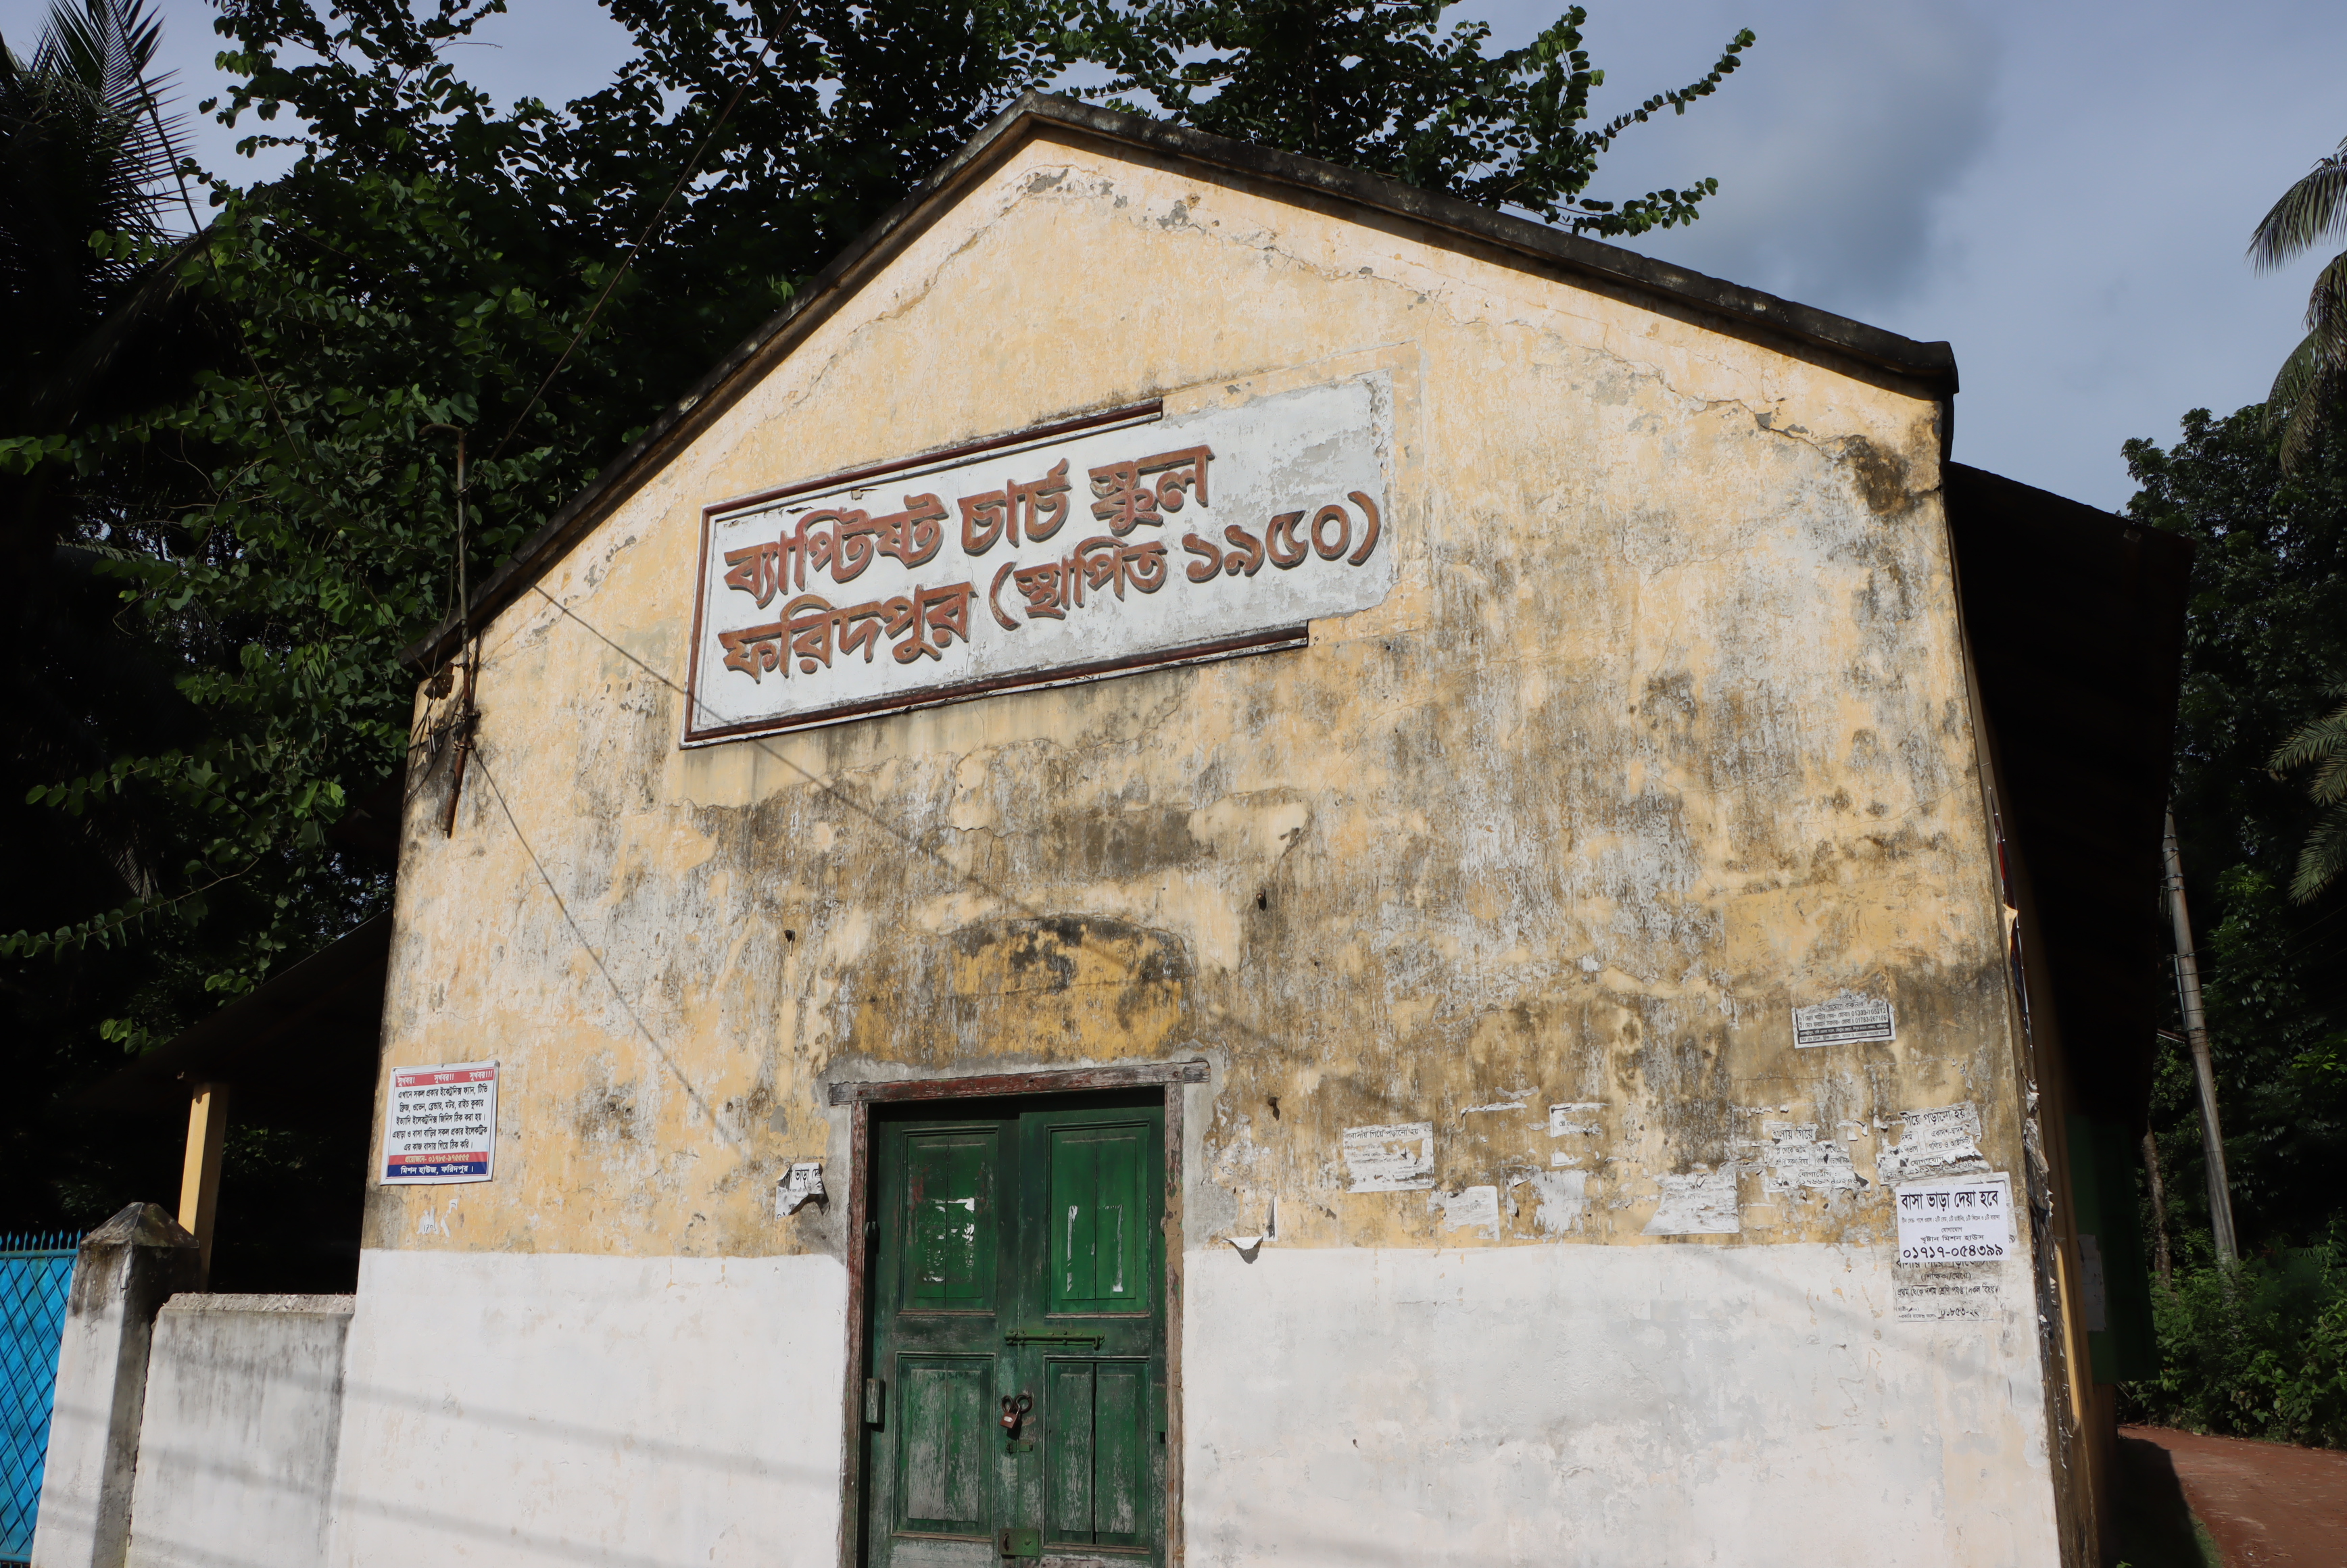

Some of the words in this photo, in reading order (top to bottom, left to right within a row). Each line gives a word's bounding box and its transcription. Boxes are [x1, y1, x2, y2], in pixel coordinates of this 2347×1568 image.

[957, 458, 1072, 556] চার্চ
[1088, 445, 1215, 537] স্কুল
[718, 581, 979, 684] ফরিদপুর
[988, 536, 1167, 631] (স্থাপিত
[1182, 491, 1380, 583] ১৯৫০)
[398, 1091, 412, 1099] এখানে
[414, 1090, 425, 1098] সকল
[426, 1089, 439, 1098] প্রকার
[477, 1083, 488, 1093] টিভি
[396, 1115, 411, 1126] ইত্যাদি
[439, 1112, 453, 1123] জিনিস
[454, 1112, 462, 1122] ঠিক
[464, 1113, 473, 1122] করা
[412, 1129, 422, 1138] বাসা
[438, 1128, 450, 1137] সকল
[451, 1127, 463, 1136] প্রকার
[404, 1143, 411, 1151] এর
[412, 1142, 422, 1151] কাজ
[450, 1139, 458, 1149] ঠিক
[400, 1165, 417, 1175] মিশন
[1900, 1192, 1923, 1210] বাসা
[1926, 1191, 1950, 1212] ভাড়া
[1954, 1190, 1977, 1208] দেয়া
[1979, 1190, 1999, 1209] হবে
[1964, 1233, 1984, 1242] হাউস
[1903, 1244, 2003, 1258] ০১৭১৭-০৫৪৩৯৯
